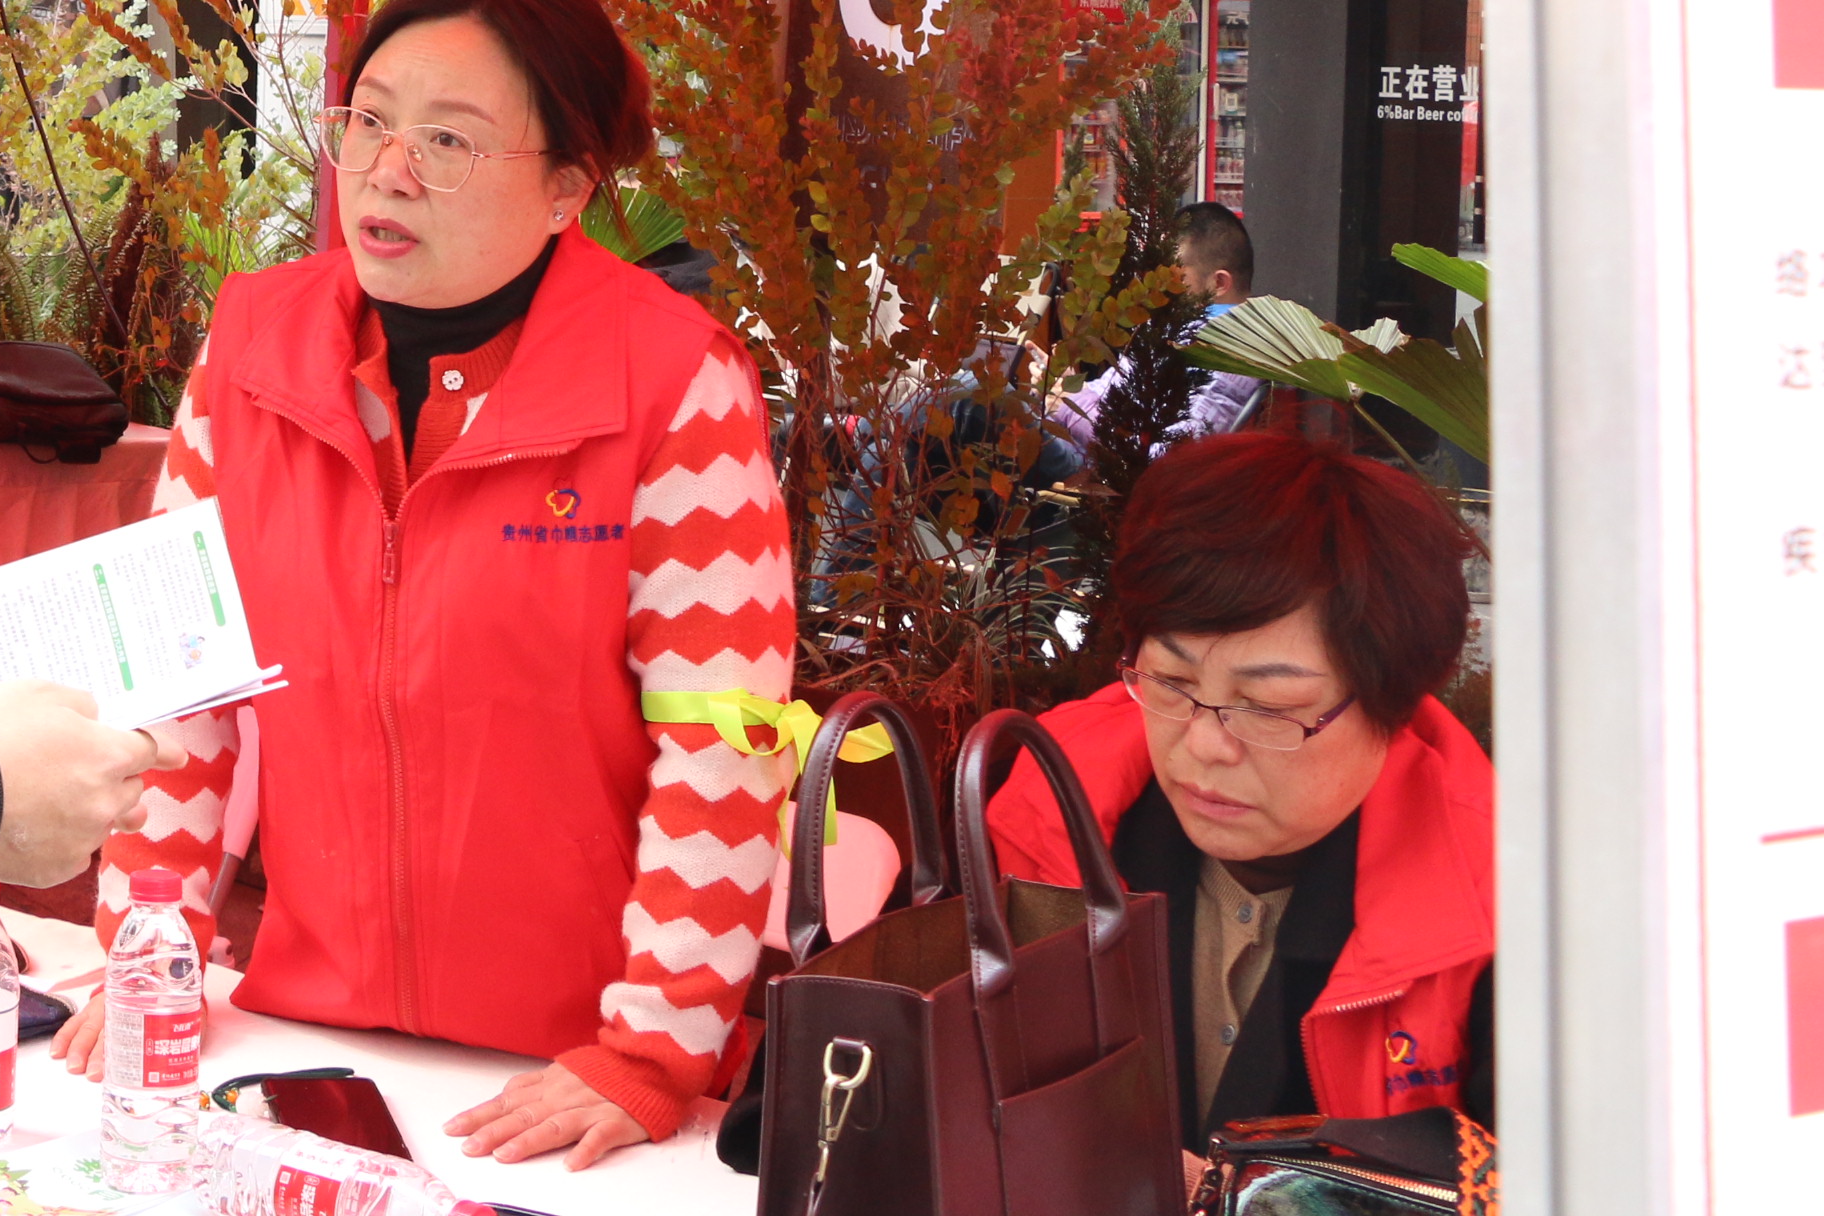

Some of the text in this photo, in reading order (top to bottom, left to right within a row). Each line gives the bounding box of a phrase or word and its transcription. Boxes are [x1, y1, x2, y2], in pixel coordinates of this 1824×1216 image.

[1378, 64, 1479, 102] 正在营业
[1377, 104, 1415, 120] 6%Bar
[1417, 106, 1445, 121] Beer
